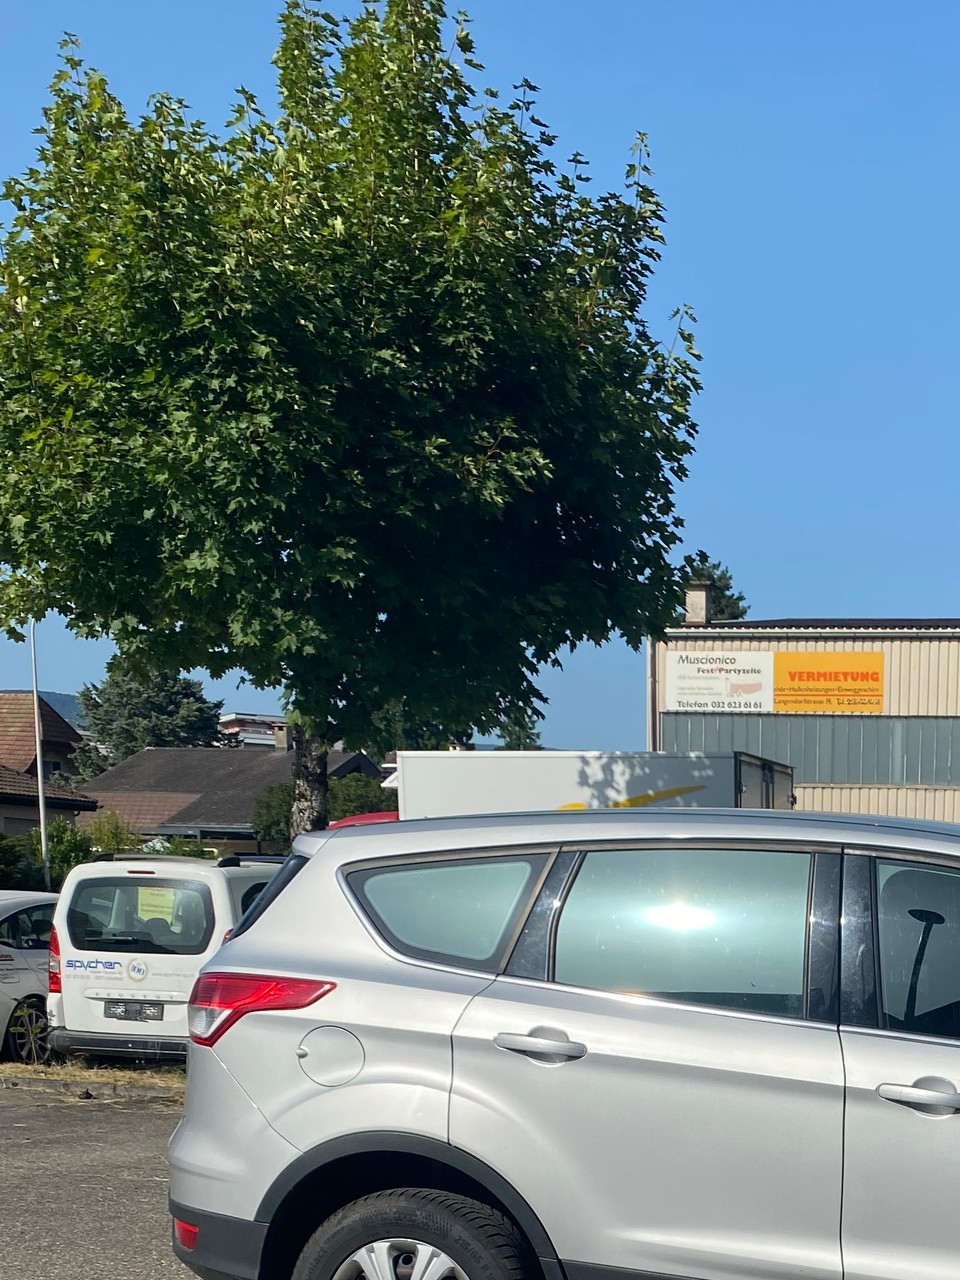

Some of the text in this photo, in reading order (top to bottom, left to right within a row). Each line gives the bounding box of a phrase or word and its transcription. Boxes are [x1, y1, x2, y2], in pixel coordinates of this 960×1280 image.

[677, 654, 736, 665] Muscionico
[788, 671, 880, 682] VERMIETUNG
[677, 701, 762, 709] Telefon 032 623 61 61
[65, 958, 123, 971] spycher
